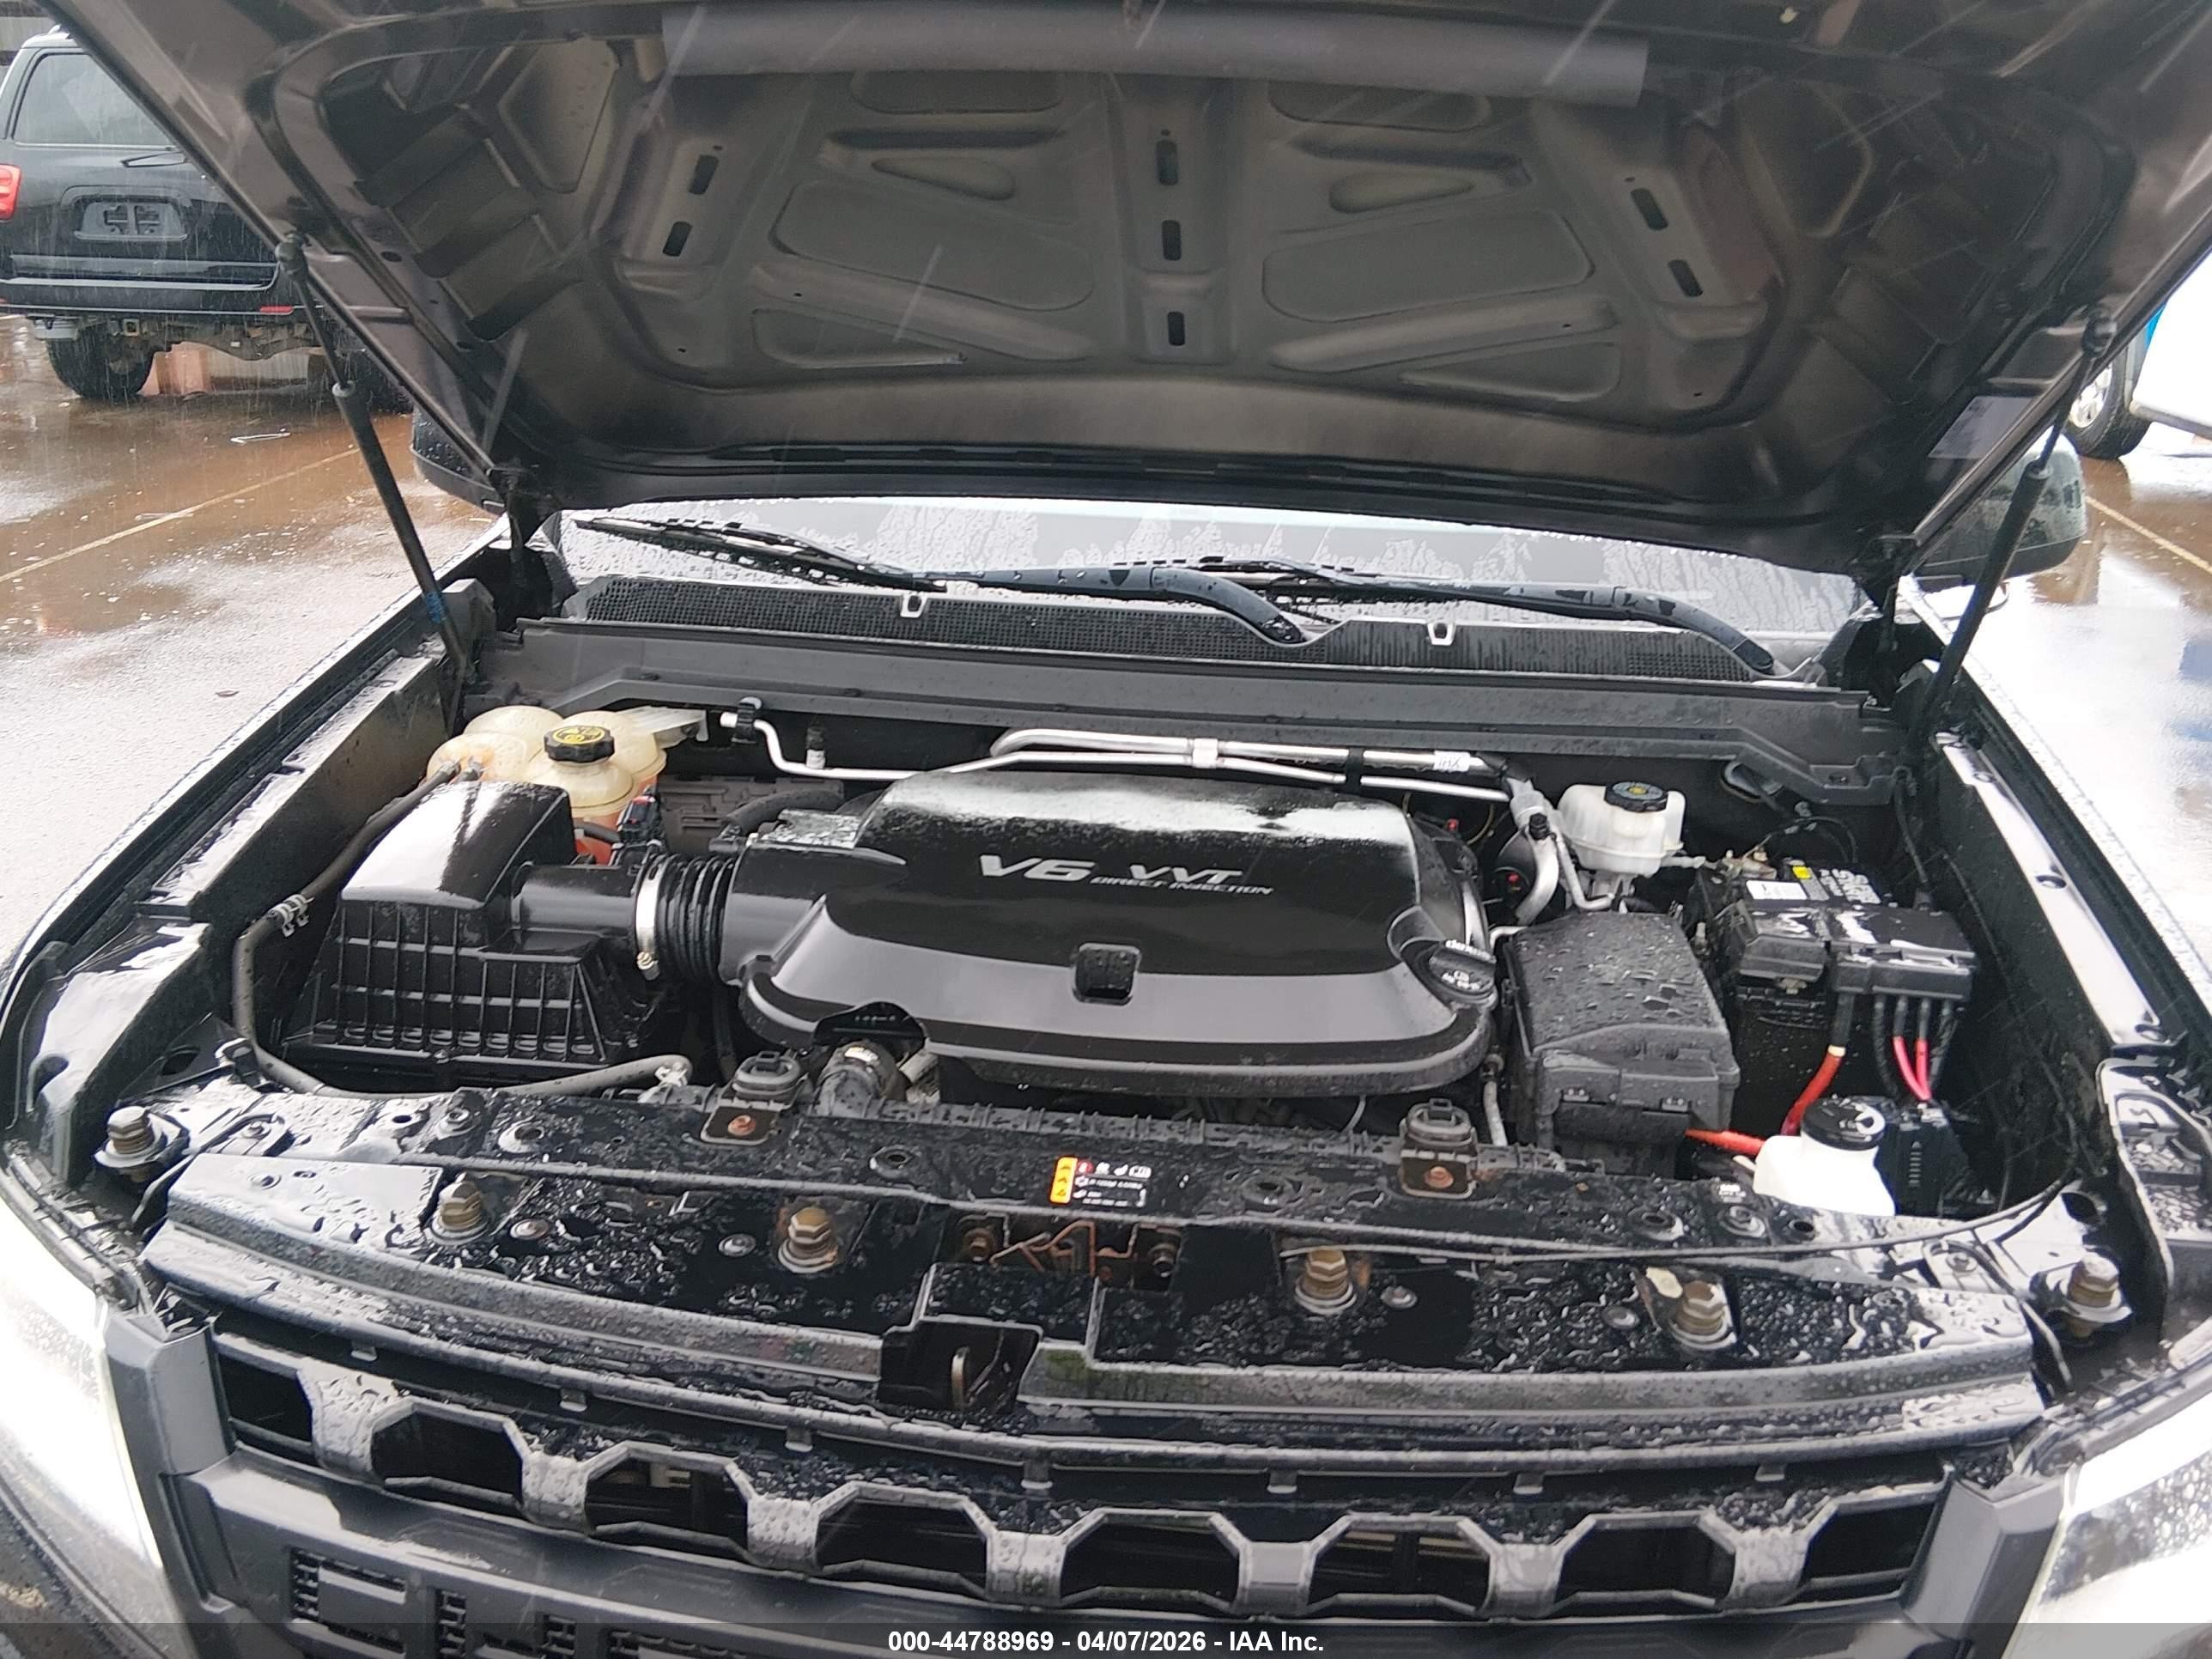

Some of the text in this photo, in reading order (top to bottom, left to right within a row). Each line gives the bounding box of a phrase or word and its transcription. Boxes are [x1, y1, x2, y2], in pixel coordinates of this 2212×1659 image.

[979, 854, 1243, 884] V6 VVT
[1090, 876, 1274, 896] DIRECT INJECTION
